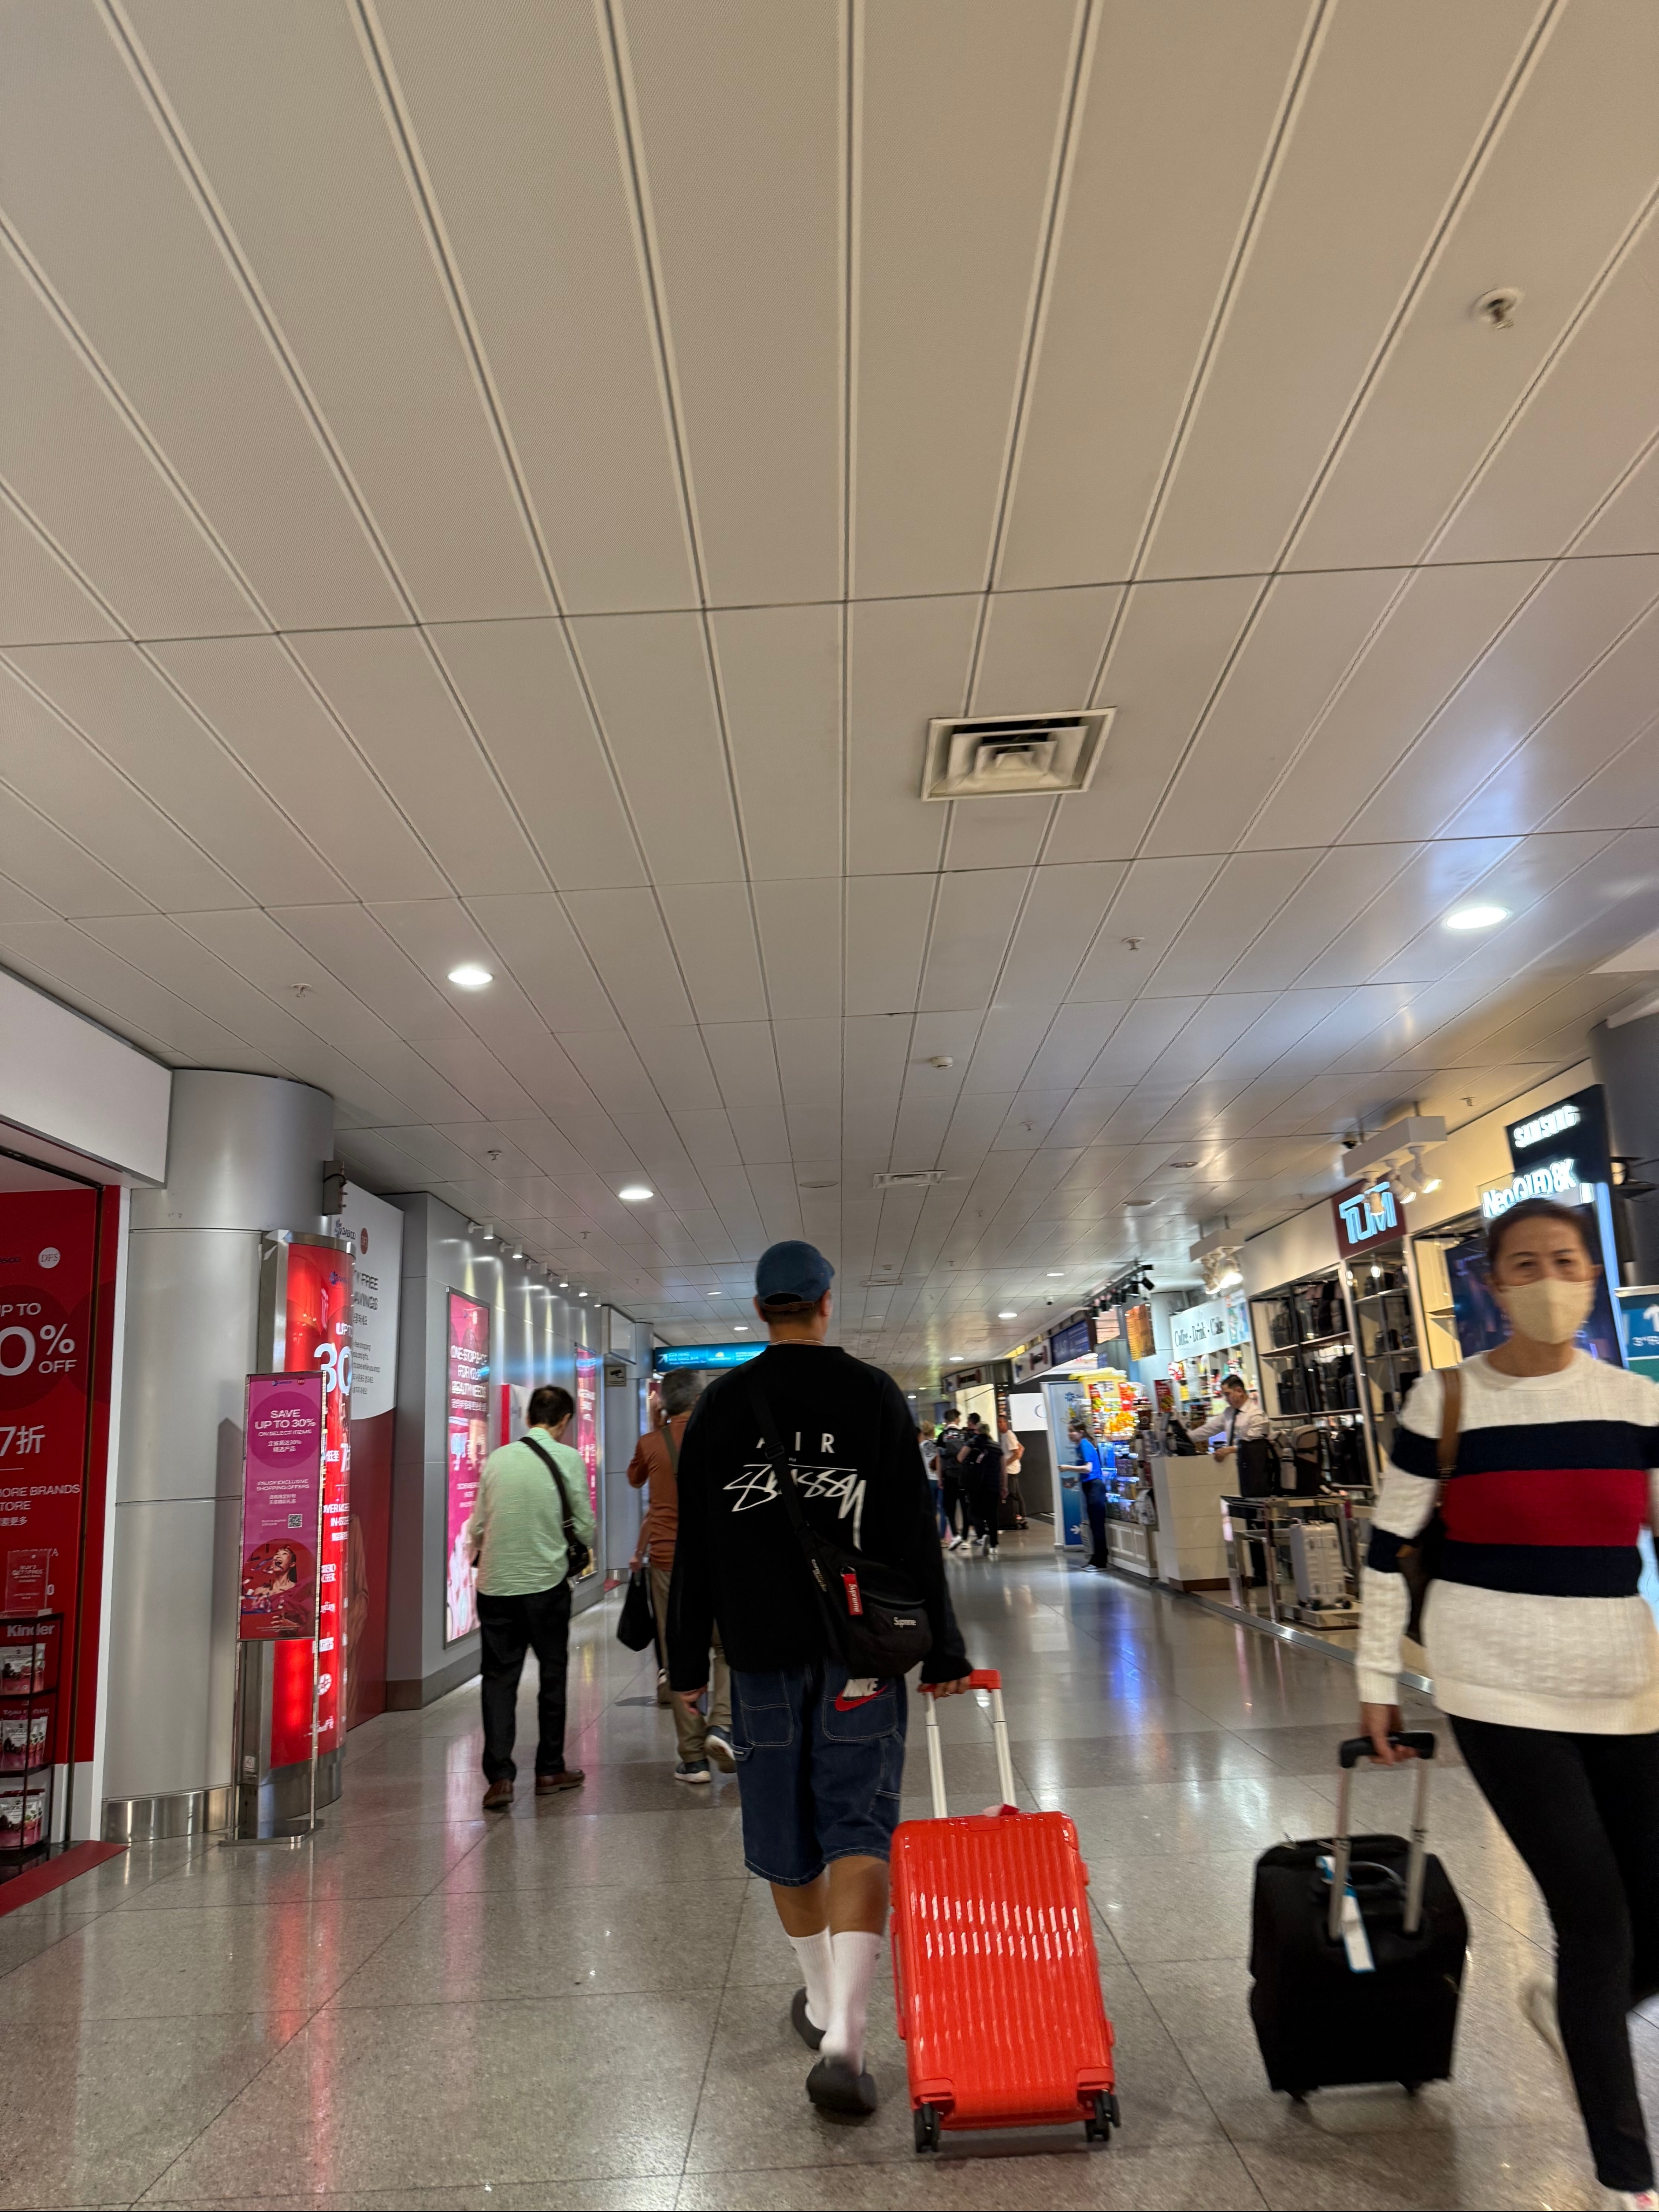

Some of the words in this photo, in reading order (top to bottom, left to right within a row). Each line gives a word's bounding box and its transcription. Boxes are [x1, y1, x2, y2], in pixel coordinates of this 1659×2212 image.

[1549, 1158, 1577, 1192] 8K
[41, 1253, 59, 1263] DFS
[361, 1273, 379, 1290] FREE
[16, 1303, 42, 1316] TO
[38, 1359, 77, 1373] OFF
[271, 1410, 301, 1418] SAVE
[255, 1420, 272, 1429] UP
[273, 1420, 290, 1428] TO
[292, 1418, 316, 1427] 30%
[30, 1485, 80, 1496] BRANDS
[894, 1617, 916, 1628] Supreme
